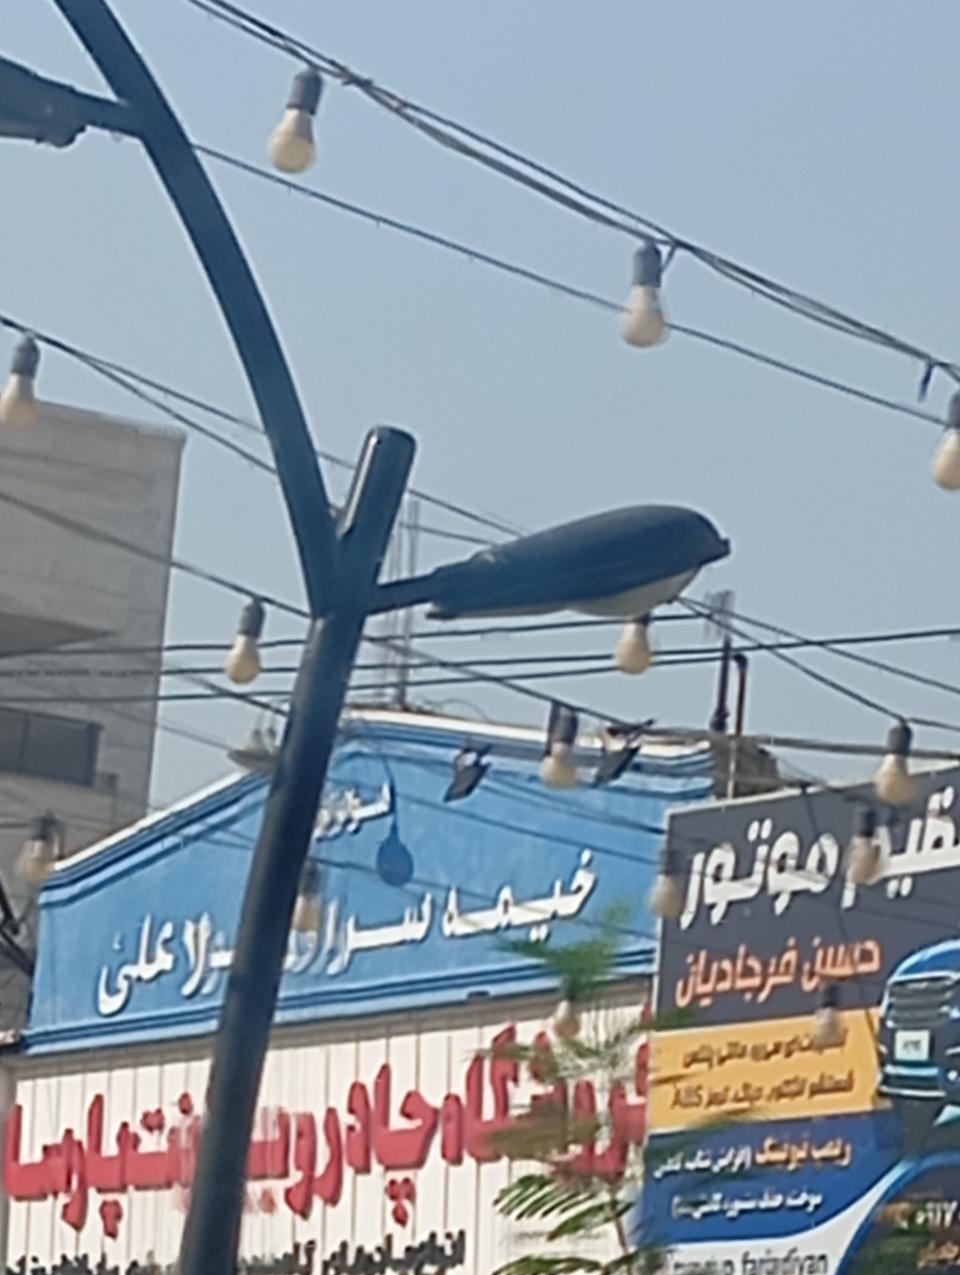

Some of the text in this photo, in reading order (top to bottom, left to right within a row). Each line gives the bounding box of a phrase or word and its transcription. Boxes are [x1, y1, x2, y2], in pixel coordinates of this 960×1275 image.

[442, 848, 596, 943] خیمه
[680, 818, 839, 931] موتور
[675, 936, 881, 1009] حسن فرجادیان
[3, 1093, 133, 1241] پارسا
[313, 1062, 439, 1229] چادر
